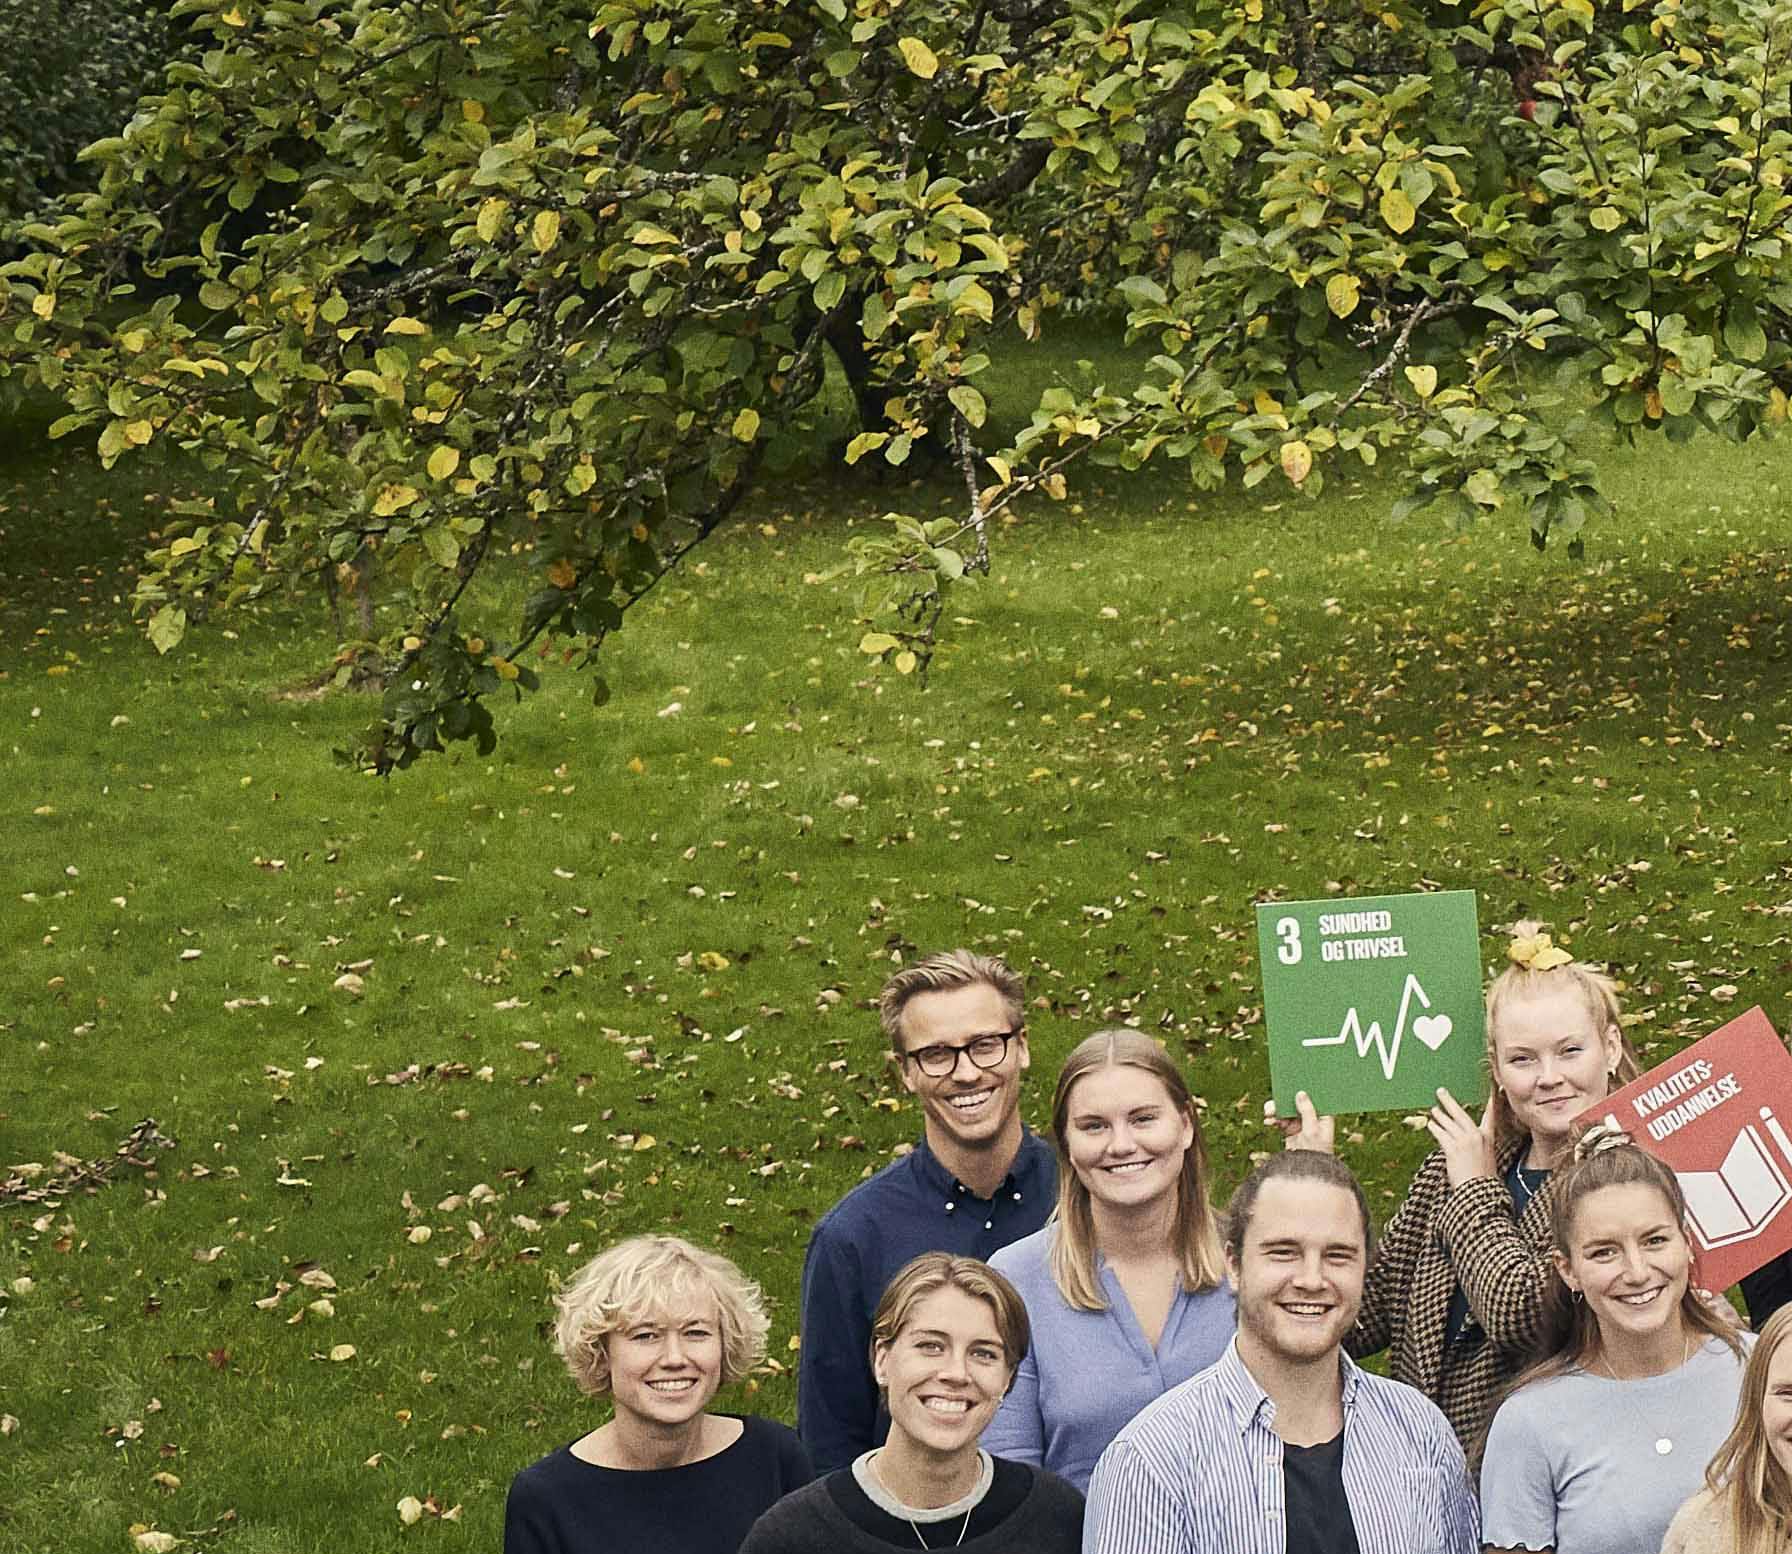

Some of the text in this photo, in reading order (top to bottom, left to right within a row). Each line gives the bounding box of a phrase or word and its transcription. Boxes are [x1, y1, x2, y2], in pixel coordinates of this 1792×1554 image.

[1276, 917, 1302, 964] 3
[1319, 911, 1392, 935] SUNDHED
[1321, 937, 1408, 962] OG TRIVSEL
[1632, 1059, 1713, 1118] KVALITETS-
[1647, 1073, 1742, 1141] UDDANNELSE
